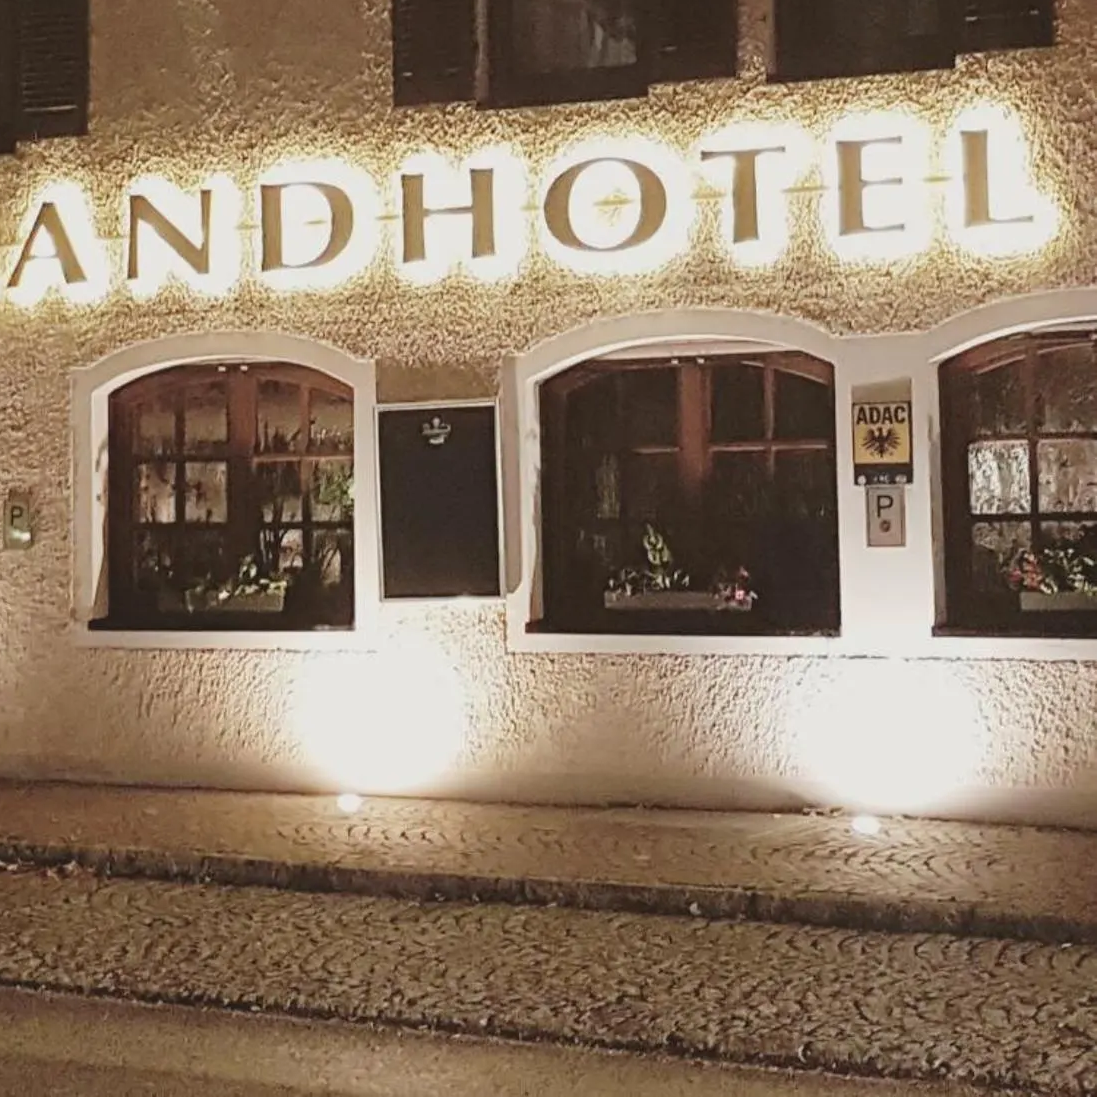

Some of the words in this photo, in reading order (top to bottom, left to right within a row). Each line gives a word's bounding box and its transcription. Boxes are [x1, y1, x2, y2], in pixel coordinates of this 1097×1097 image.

[855, 405, 907, 426] ADAC
[10, 505, 24, 527] P
[876, 494, 894, 519] P
